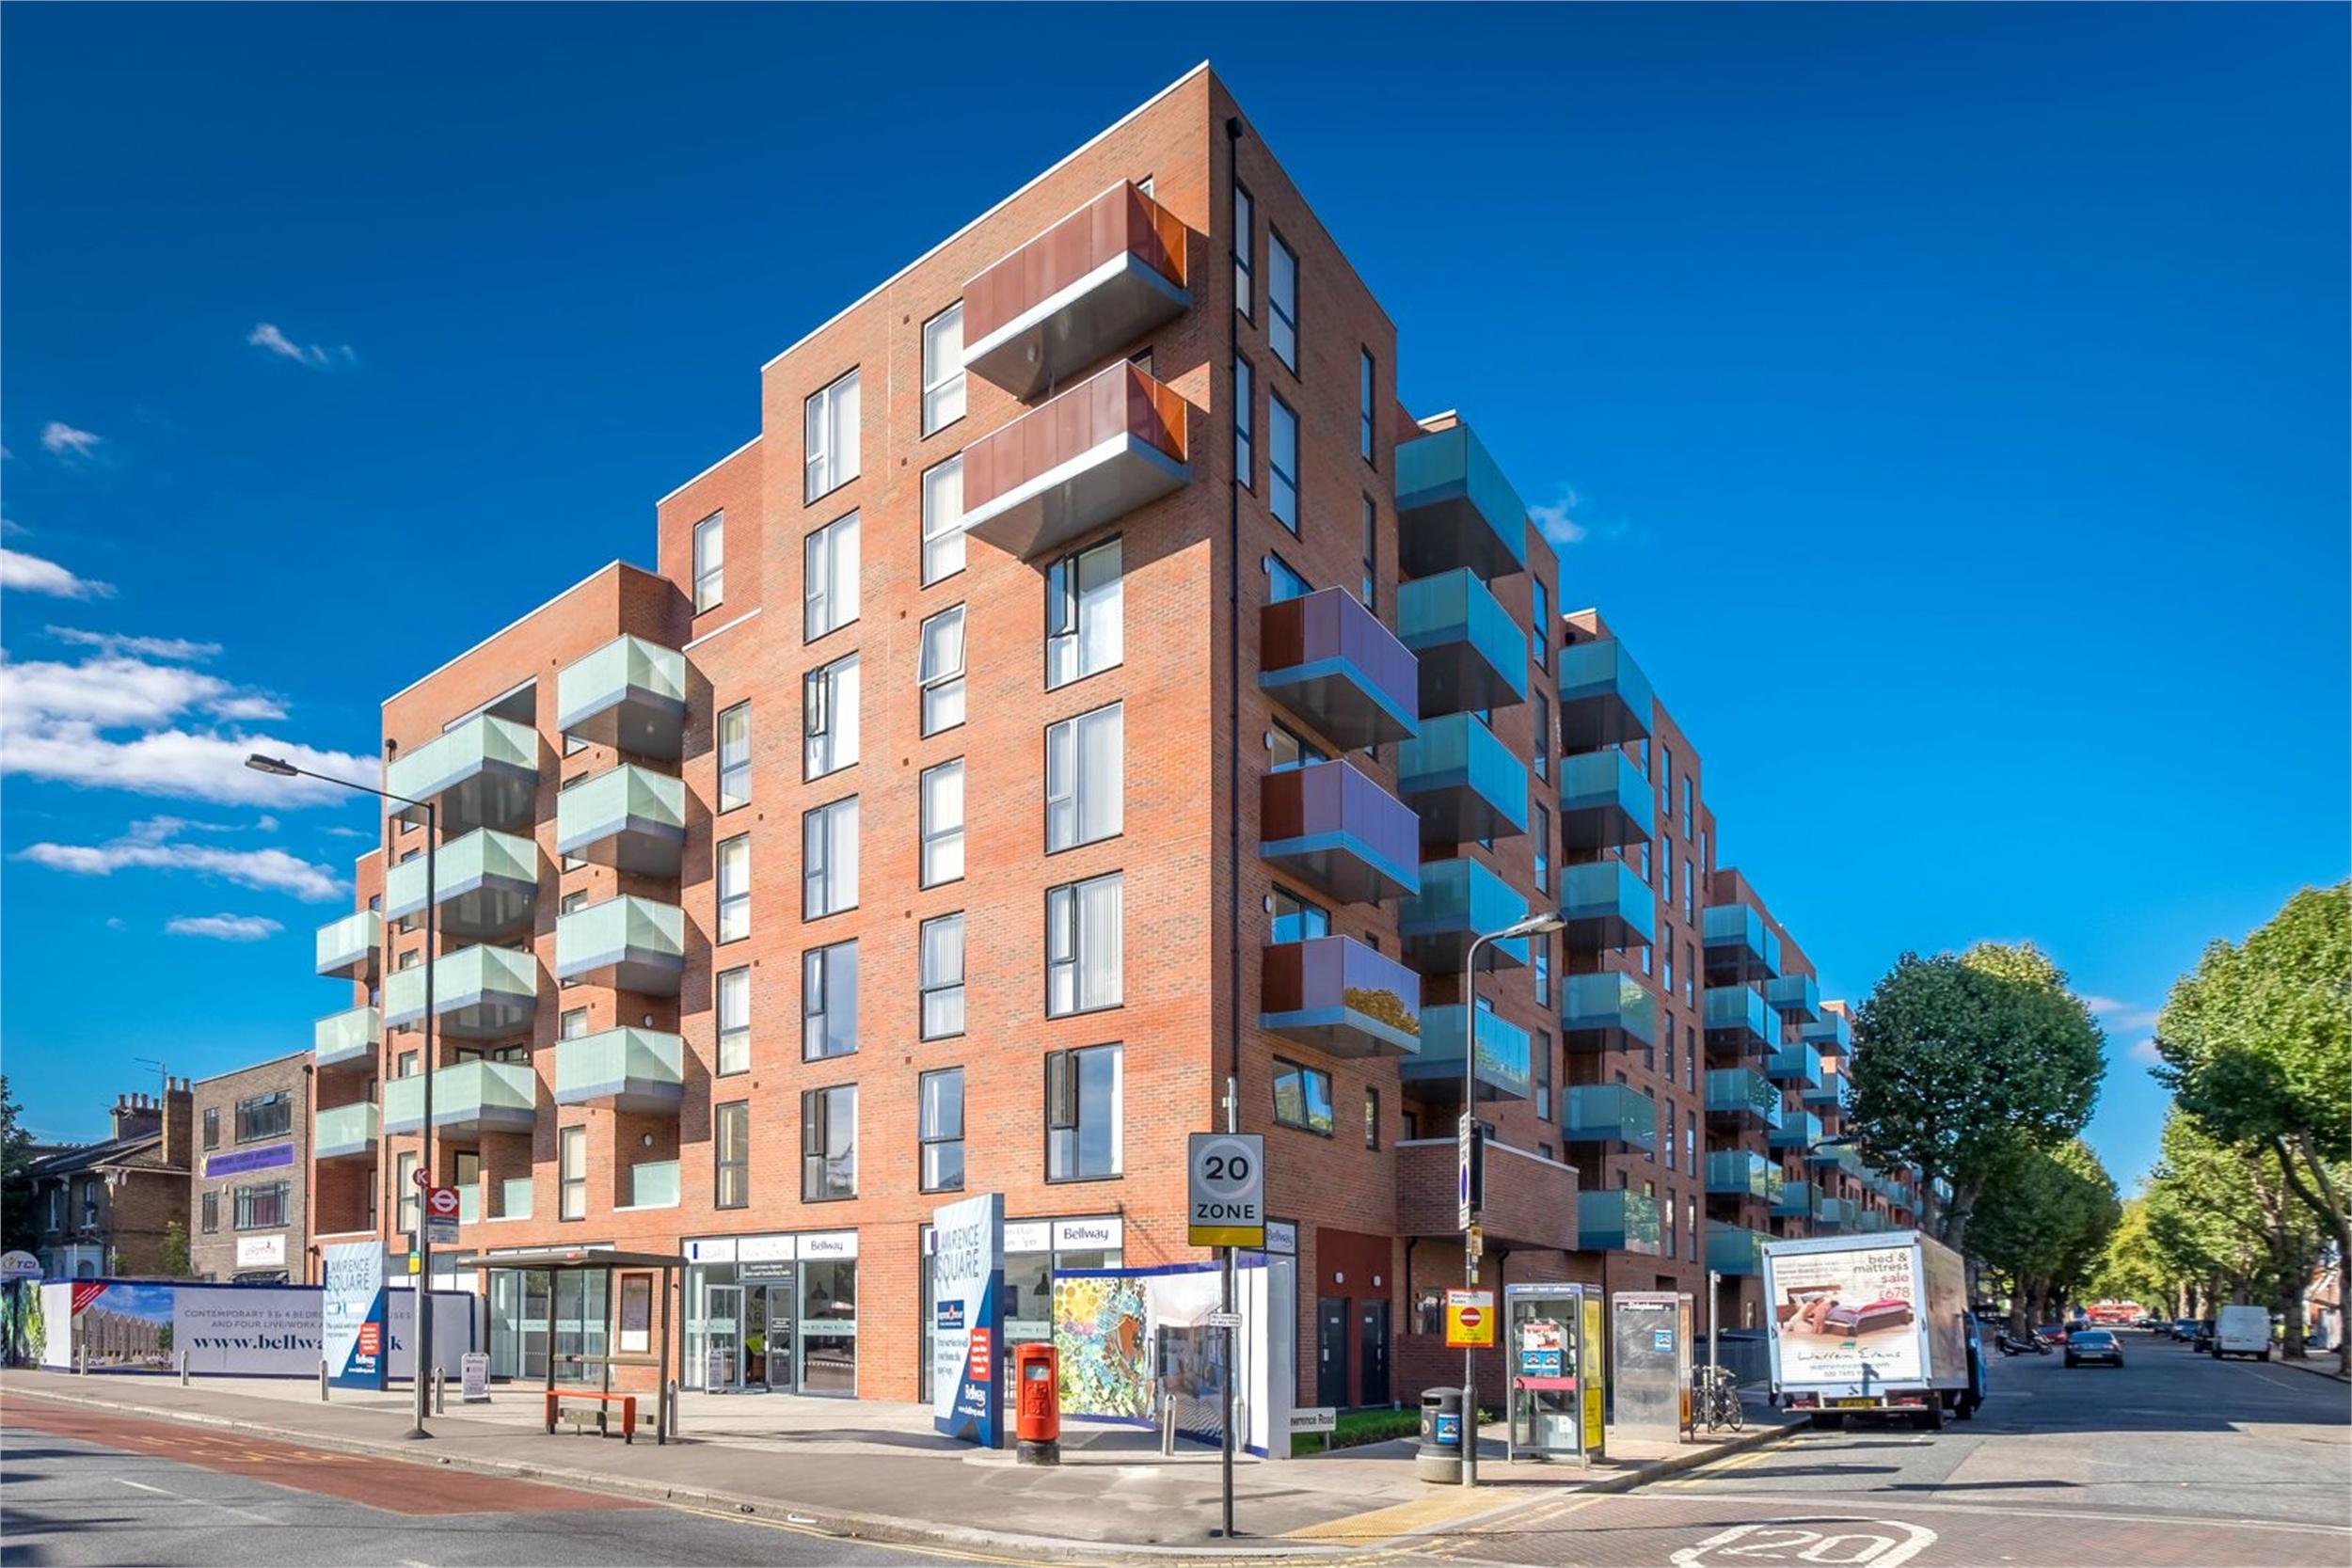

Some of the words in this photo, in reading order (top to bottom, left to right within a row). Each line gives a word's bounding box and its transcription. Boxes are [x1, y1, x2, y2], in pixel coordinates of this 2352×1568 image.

[1205, 1156, 1248, 1180] 20
[417, 1171, 429, 1184] K
[1197, 1204, 1255, 1219] ZONE
[1063, 1227, 1109, 1241] Bellway
[810, 1241, 844, 1251] Bellway
[1867, 1253, 1894, 1264] bed
[1899, 1252, 1908, 1262] &
[936, 1248, 979, 1289] SQUARE
[1853, 1262, 1910, 1274] mattress
[327, 1273, 370, 1295] SQUARE
[1882, 1273, 1910, 1283] sale
[1880, 1287, 1911, 1299] £678
[184, 1309, 264, 1318] CONTEMPORARY
[1797, 1352, 1853, 1361] Warren
[1858, 1347, 1901, 1359] Evans
[1717, 1529, 1897, 1563] 20
